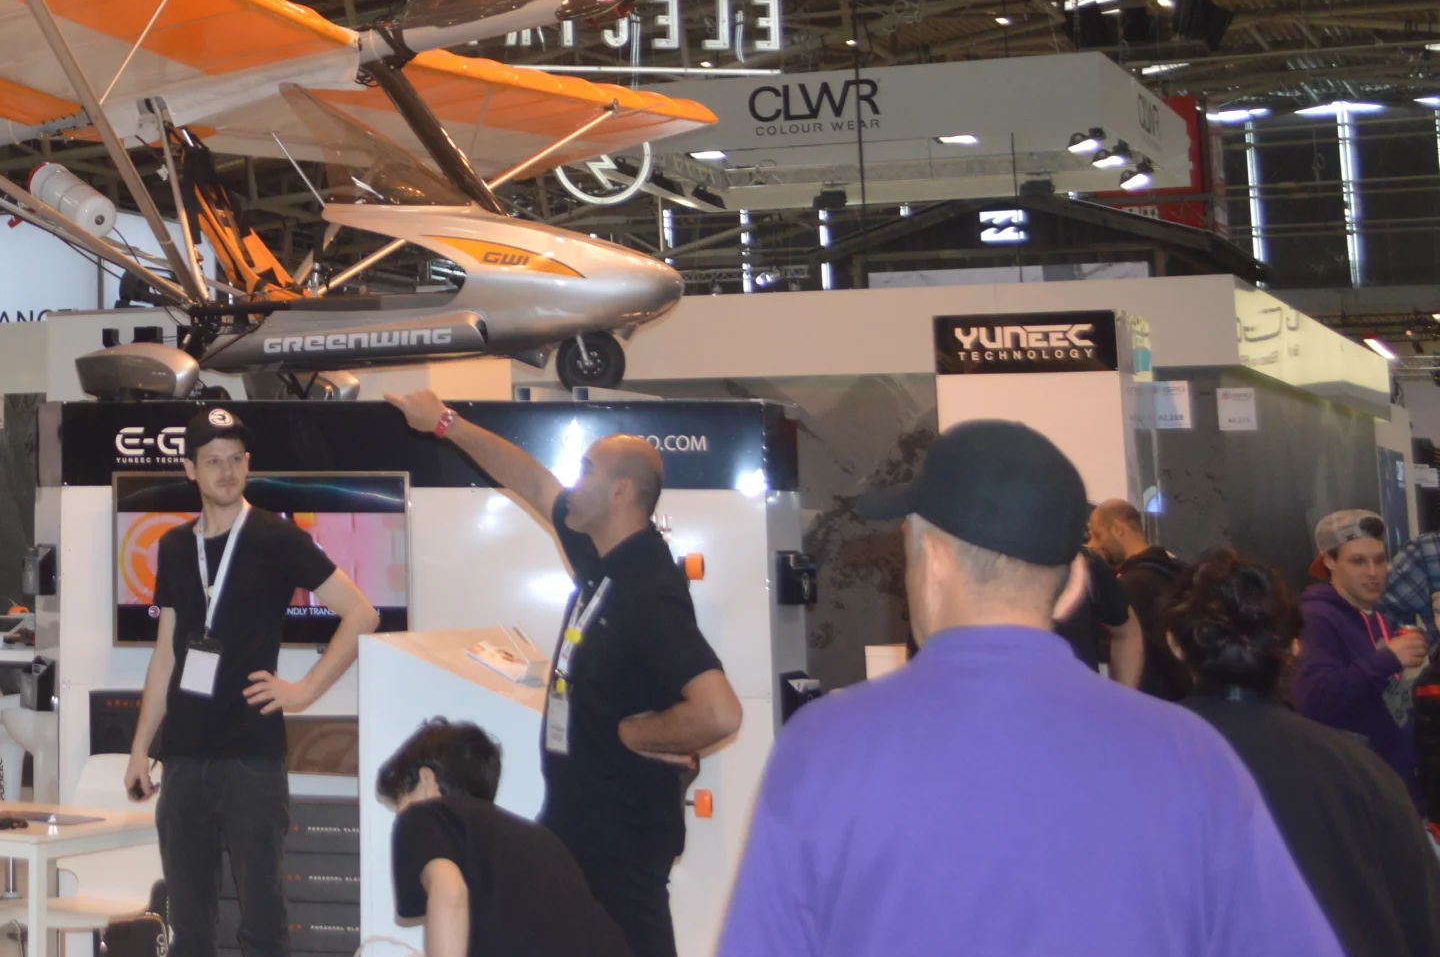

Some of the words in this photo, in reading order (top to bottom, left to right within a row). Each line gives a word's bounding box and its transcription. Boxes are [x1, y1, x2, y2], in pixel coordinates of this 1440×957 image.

[748, 78, 882, 123] CLWR
[755, 122, 823, 136] COLOUR
[831, 118, 881, 131] WEAR
[482, 251, 530, 266] GWI
[263, 328, 452, 354] GREENWING
[954, 323, 1096, 349] YUNEEC
[958, 348, 1094, 362] TECHNOLOGY
[116, 427, 187, 455] E-G
